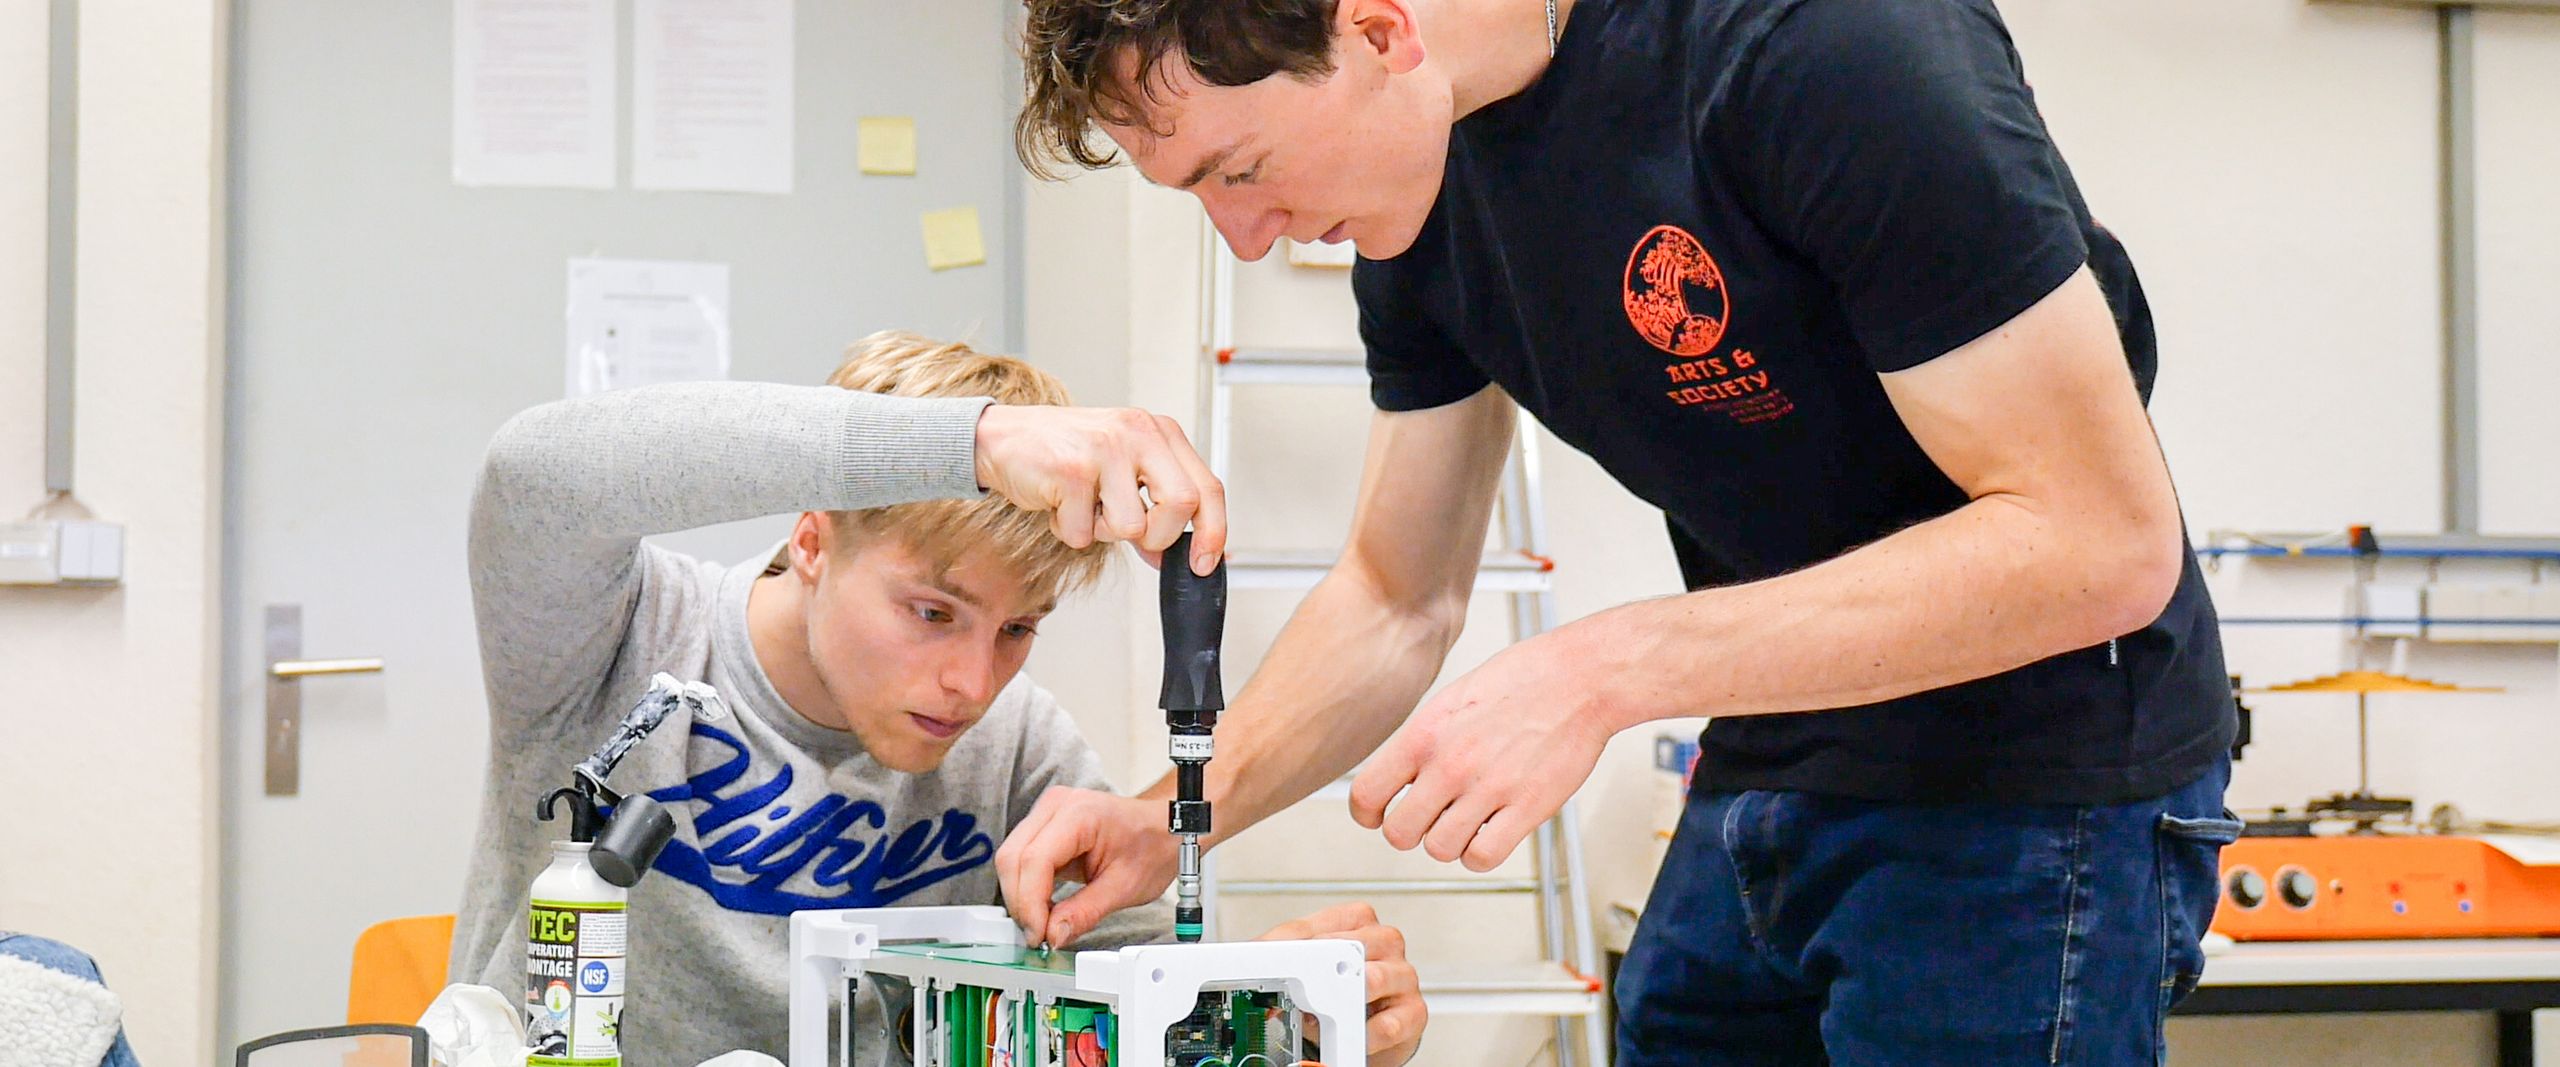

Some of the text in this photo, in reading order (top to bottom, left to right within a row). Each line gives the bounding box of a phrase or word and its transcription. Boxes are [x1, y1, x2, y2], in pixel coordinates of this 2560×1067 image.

[1664, 348, 1756, 384] ARTS &
[1665, 369, 1769, 405] SOCIETY
